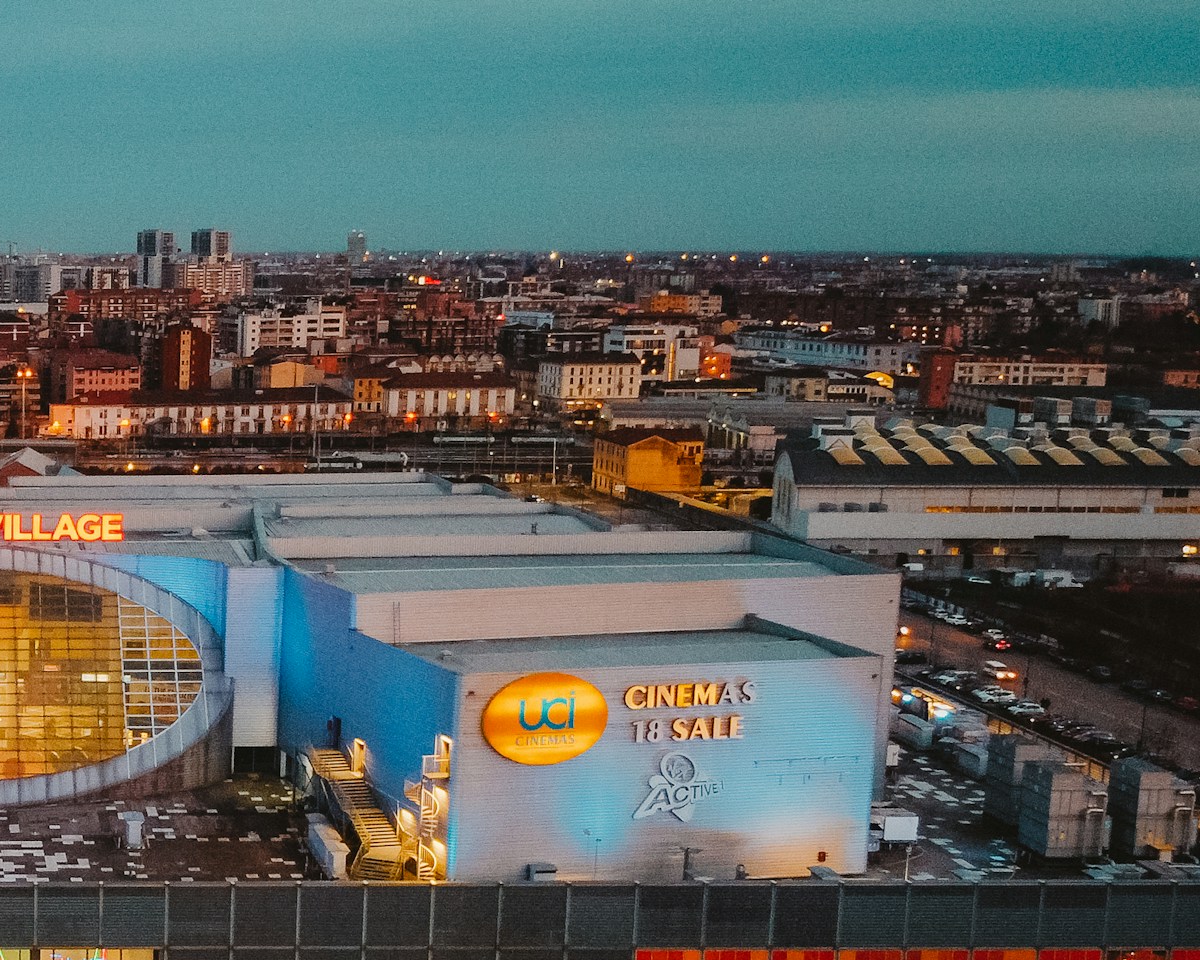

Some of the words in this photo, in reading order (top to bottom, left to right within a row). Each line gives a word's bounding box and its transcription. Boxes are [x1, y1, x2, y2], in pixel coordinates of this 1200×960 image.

[624, 680, 758, 711] CINEMAS
[515, 733, 576, 747] CINEMAS
[632, 718, 664, 744] 18
[671, 714, 745, 742] SALE
